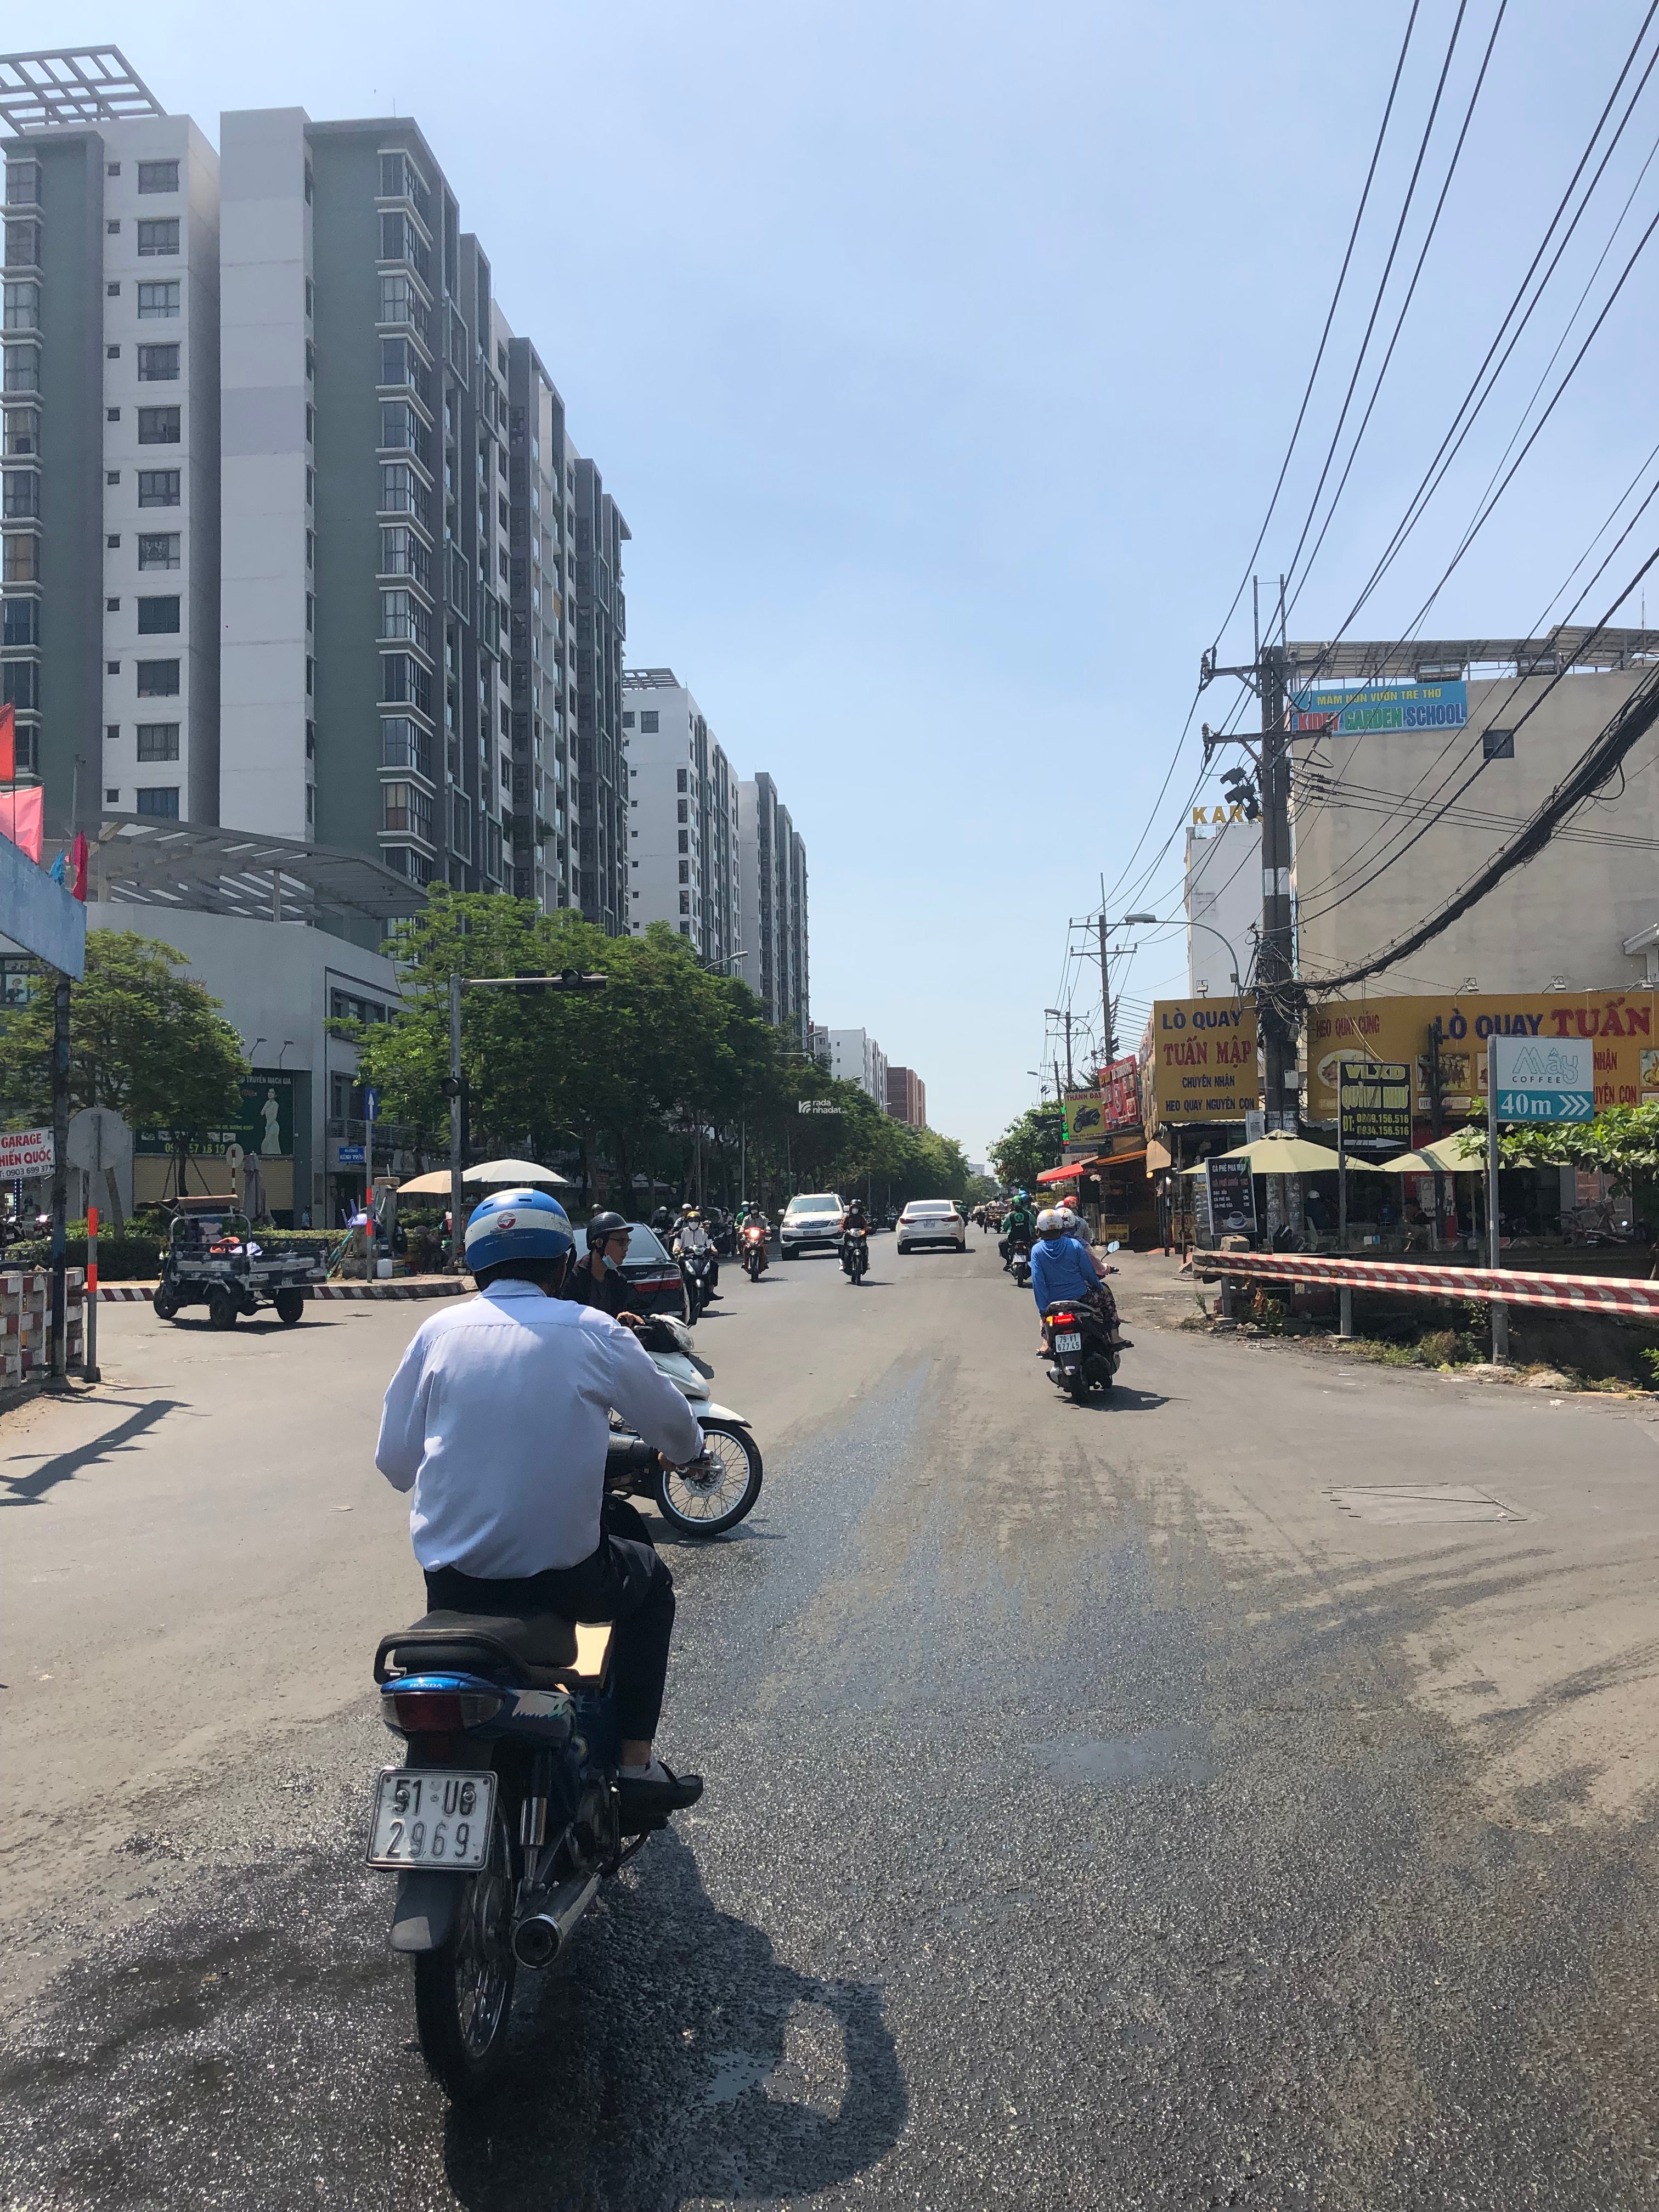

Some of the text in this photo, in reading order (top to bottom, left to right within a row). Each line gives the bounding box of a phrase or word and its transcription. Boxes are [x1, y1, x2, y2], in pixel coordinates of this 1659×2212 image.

[1421, 687, 1443, 698] THƠ
[1344, 706, 1404, 730] GARDEN
[1406, 703, 1466, 726] SCHOOL
[1163, 1007, 1243, 1030] LÒ QUAY
[1435, 997, 1651, 1040] LÒ QUAY TUẤN
[1163, 1035, 1252, 1068] TUẤN MẬP
[1593, 1048, 1618, 1075] NHẬN
[1345, 1064, 1406, 1080] VLXD
[1512, 1046, 1578, 1085] Mây
[1182, 1073, 1235, 1090] CHUYÊN NHẬN
[1512, 1076, 1561, 1084] COFFEE
[1383, 1085, 1409, 1109] NHƯ
[1501, 1093, 1553, 1115] 40m
[1593, 1082, 1637, 1105] UYÊN CON
[1166, 1096, 1255, 1113] HEO QUAY NGUYÊN CON
[1, 1133, 42, 1149] GARAGE
[1357, 1125, 1409, 1136] 0934.156.516
[0, 1146, 52, 1167] HIẾN QUỐC
[215, 1144, 225, 1154] 19
[6, 1168, 25, 1177] 0903
[1057, 1341, 1080, 1351] 627.45
[385, 1819, 470, 1858] 2969
